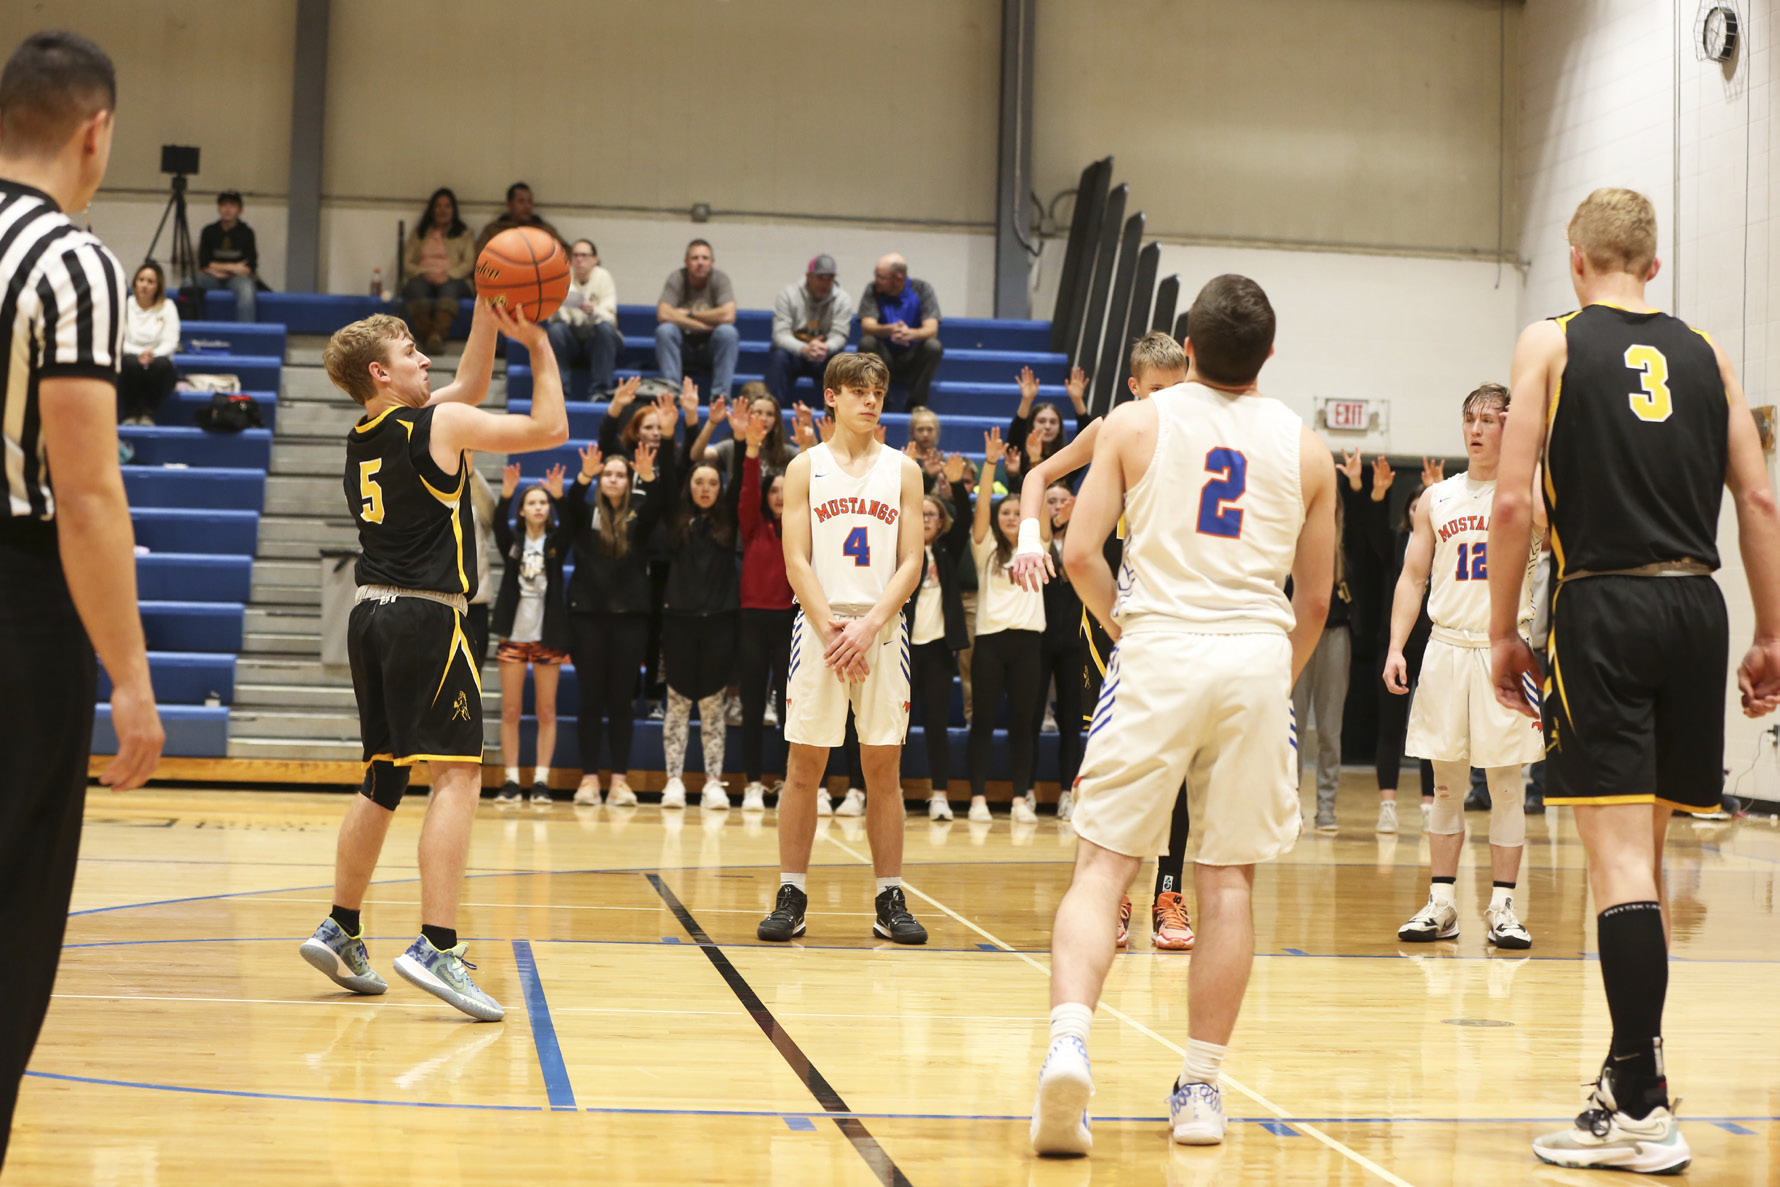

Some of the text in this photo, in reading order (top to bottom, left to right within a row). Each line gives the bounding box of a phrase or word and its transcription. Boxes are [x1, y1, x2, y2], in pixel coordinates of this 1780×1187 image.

[1624, 344, 1673, 422] 3
[1335, 403, 1363, 426] EXIT
[358, 458, 384, 525] 5
[813, 497, 899, 526] MUSTANGS
[1196, 446, 1247, 539] 2
[842, 526, 870, 567] 4
[1437, 515, 1489, 543] MUSTA
[1455, 541, 1489, 581] 12
